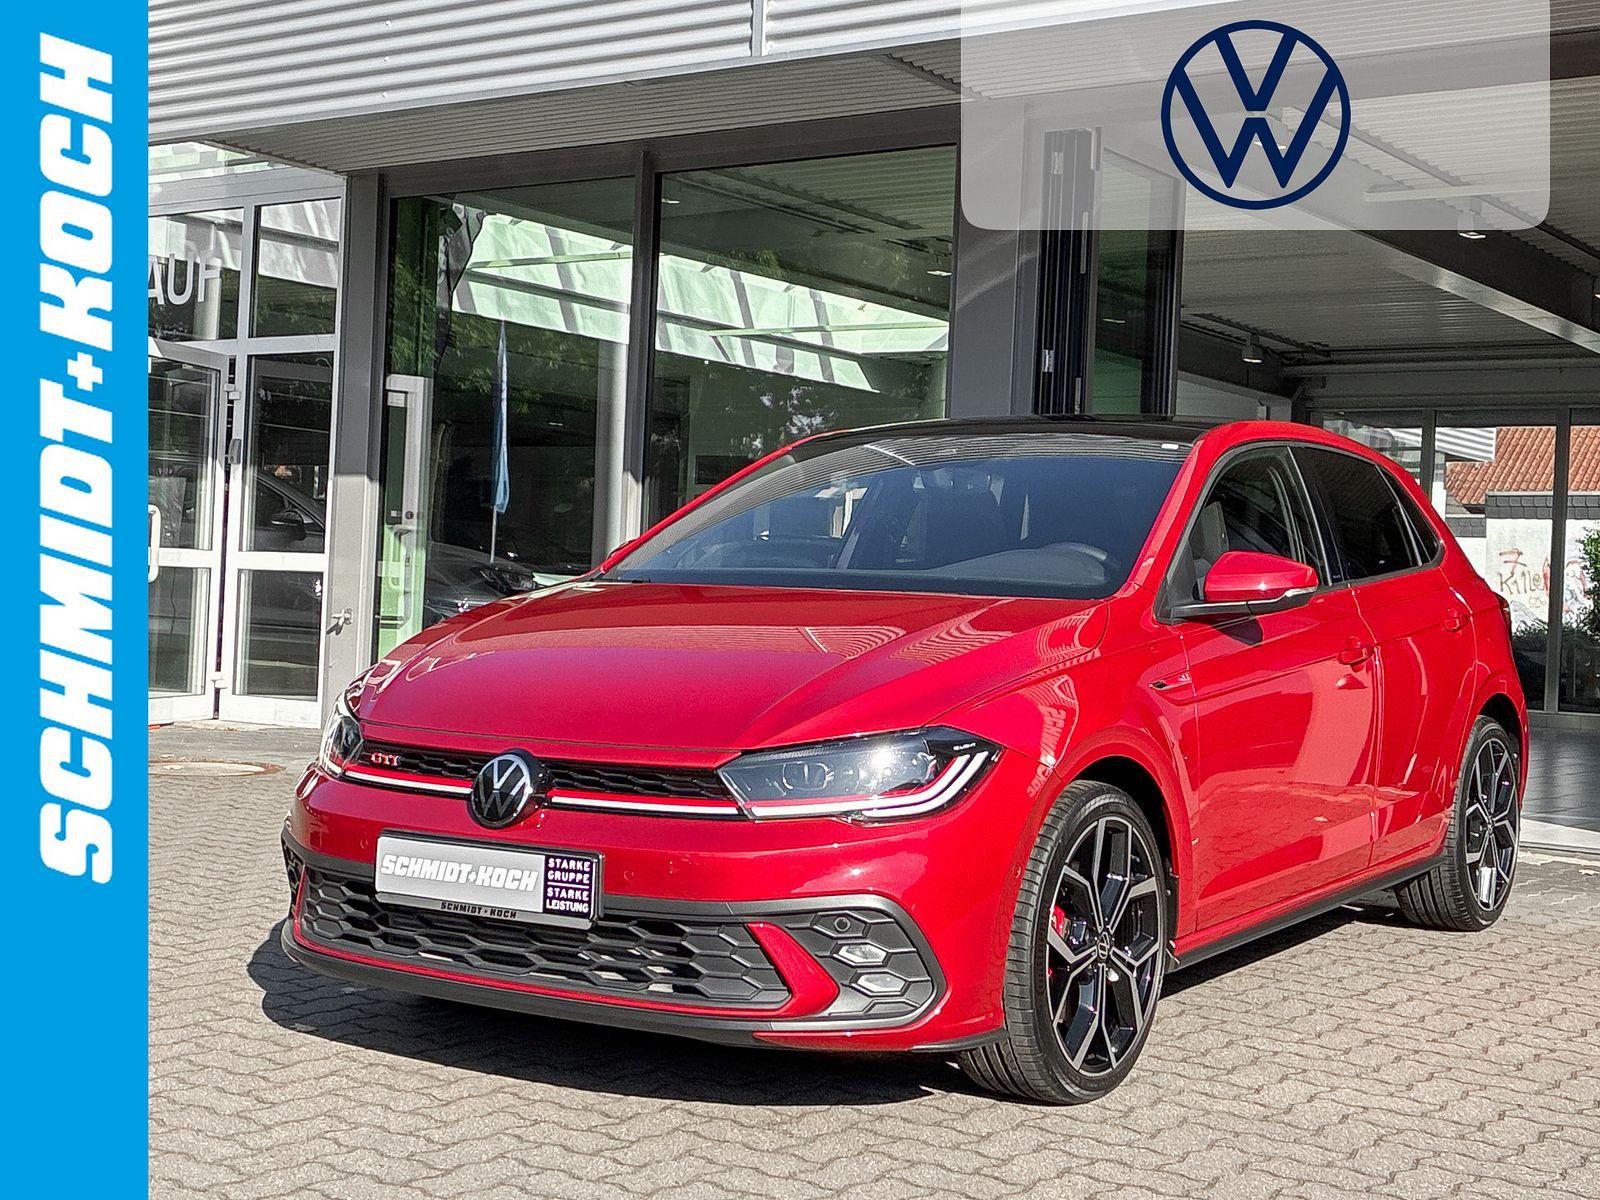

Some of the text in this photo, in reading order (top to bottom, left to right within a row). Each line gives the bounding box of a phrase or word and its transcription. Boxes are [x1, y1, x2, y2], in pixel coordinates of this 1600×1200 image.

[371, 752, 401, 767] GTI
[548, 858, 590, 872] STARKE
[547, 870, 590, 884] GRUPPE
[547, 887, 589, 901] STARKE
[546, 899, 589, 913] LEISTUNG
